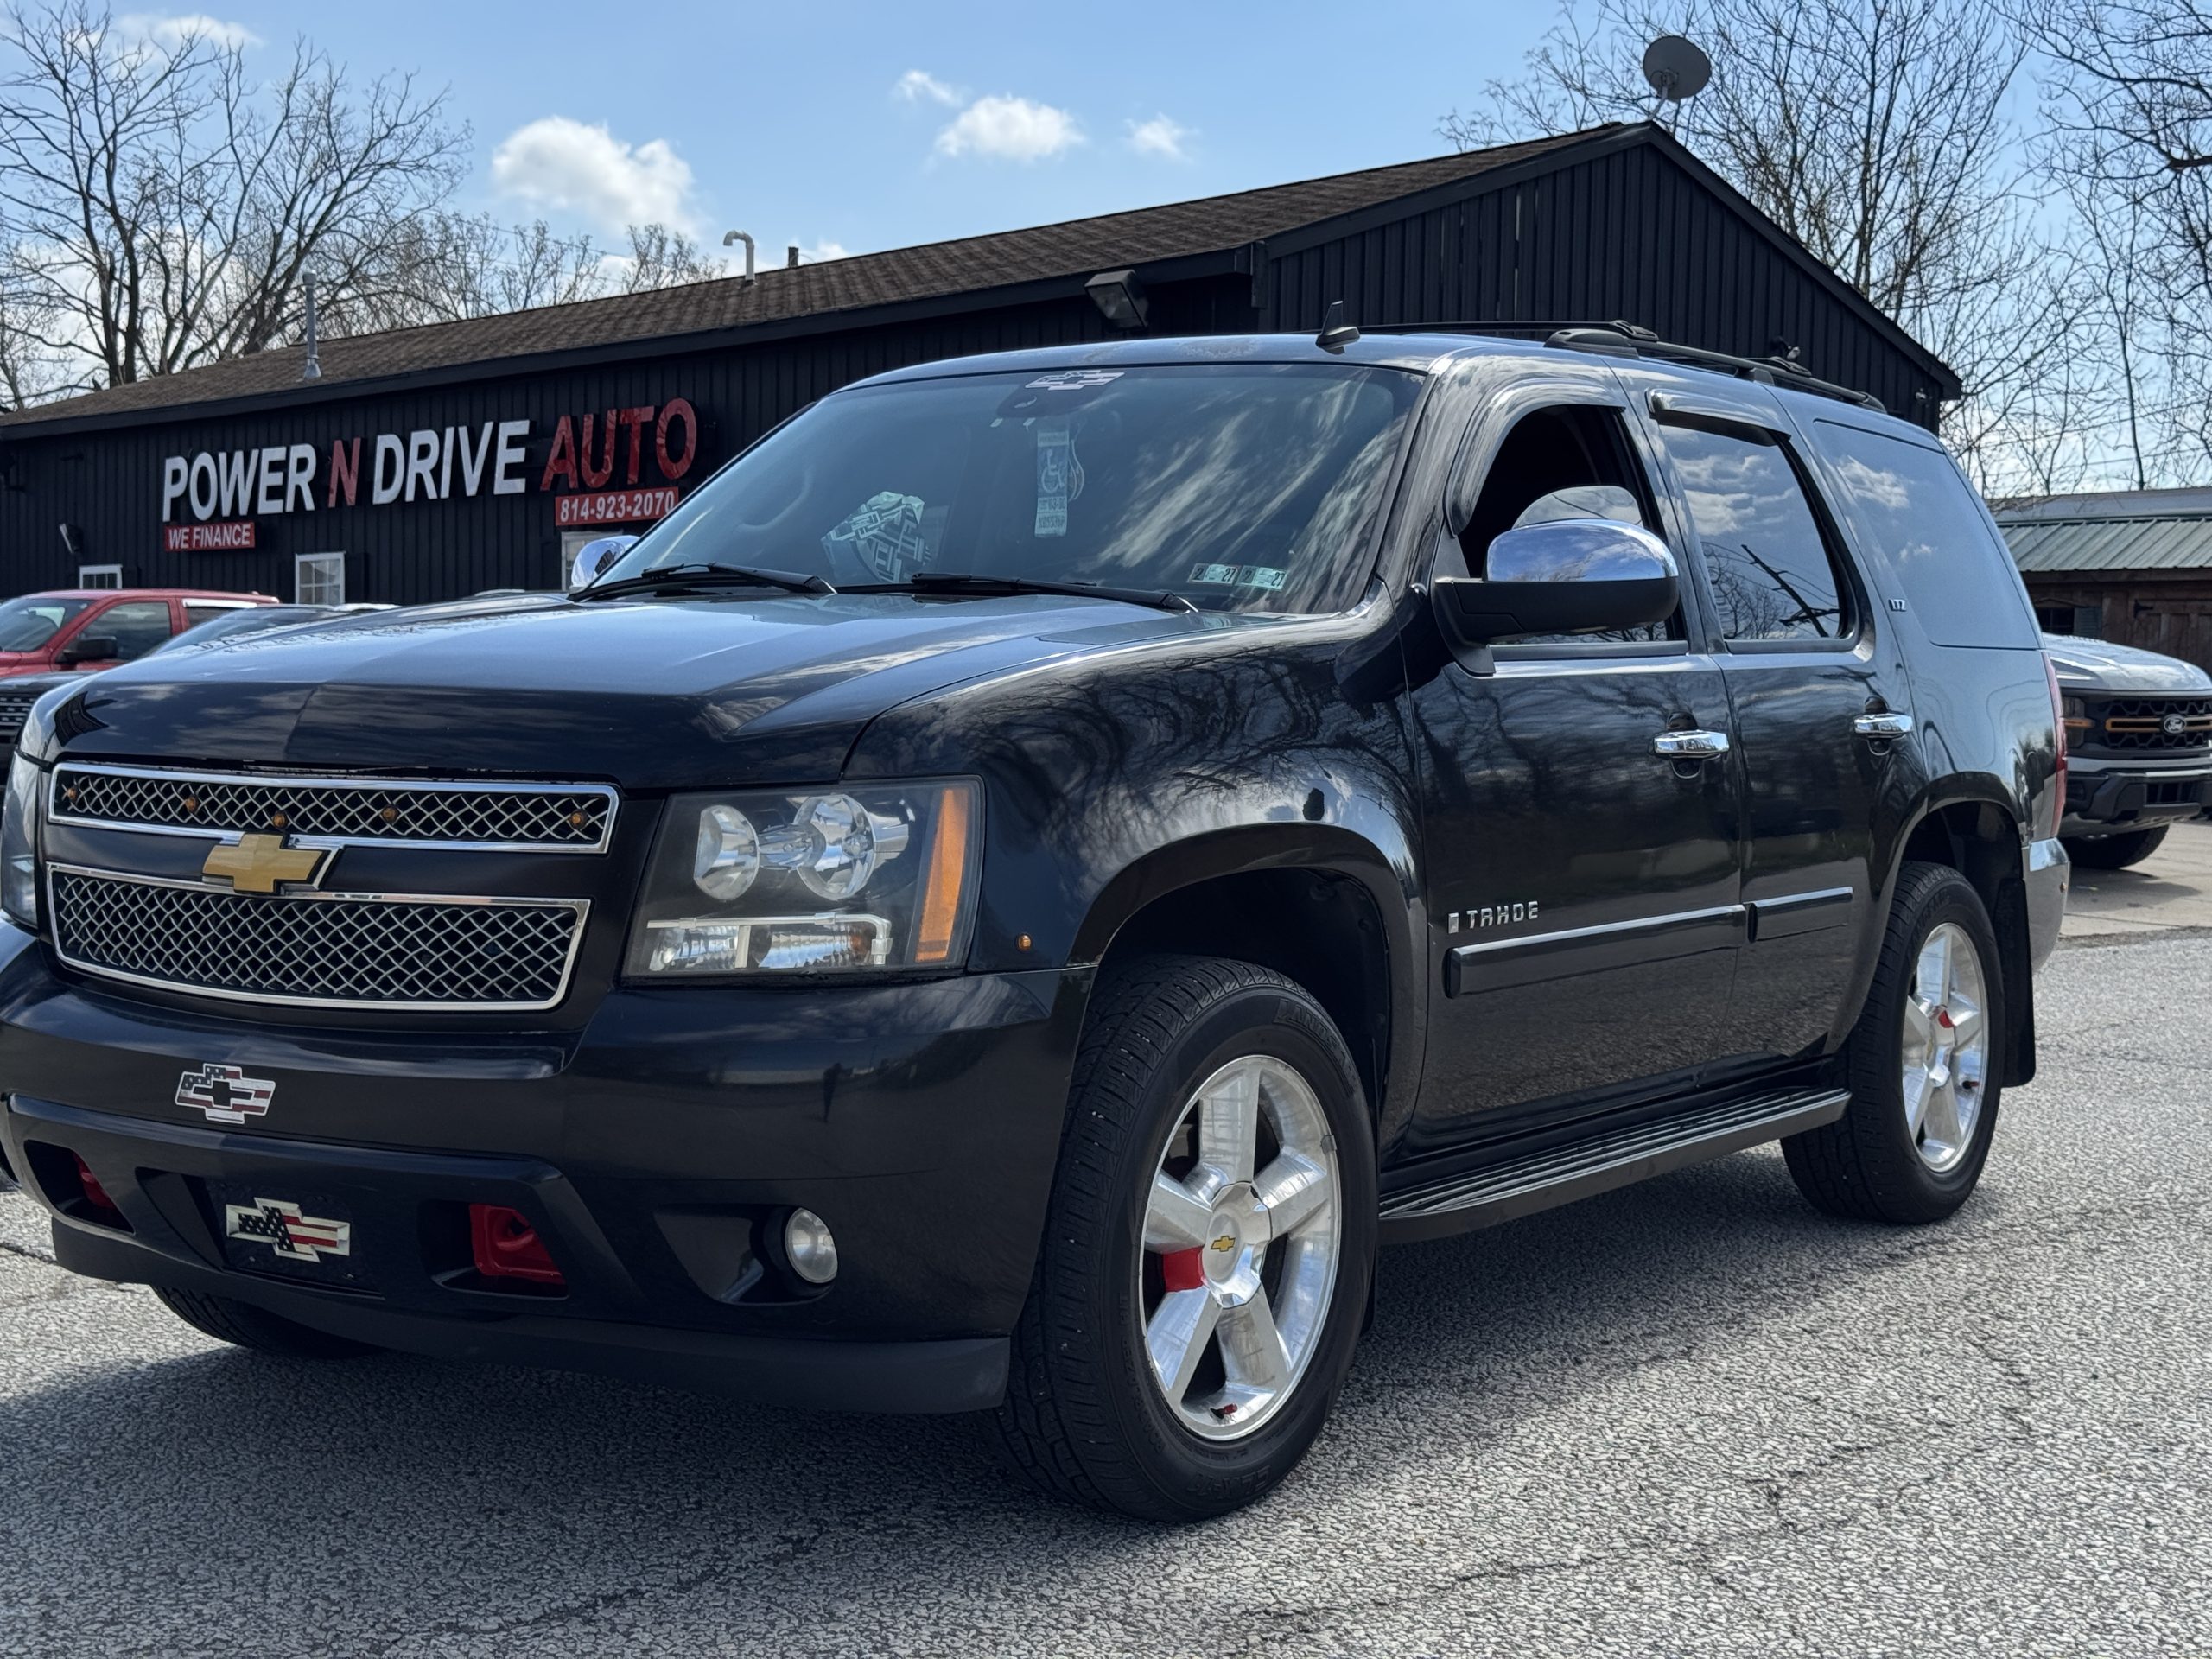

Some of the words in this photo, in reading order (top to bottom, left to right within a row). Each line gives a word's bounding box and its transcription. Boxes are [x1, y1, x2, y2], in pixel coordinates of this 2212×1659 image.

[162, 442, 317, 523] POWER
[327, 435, 362, 509] N
[372, 419, 531, 505] DRIVE
[539, 397, 698, 492] AUTO
[560, 490, 676, 523] 814-923-2070
[168, 527, 190, 550] WE
[192, 523, 251, 549] FINANCE
[1222, 567, 1236, 582] 27
[1270, 571, 1286, 587] 27
[1466, 900, 1539, 930] TAHOE
